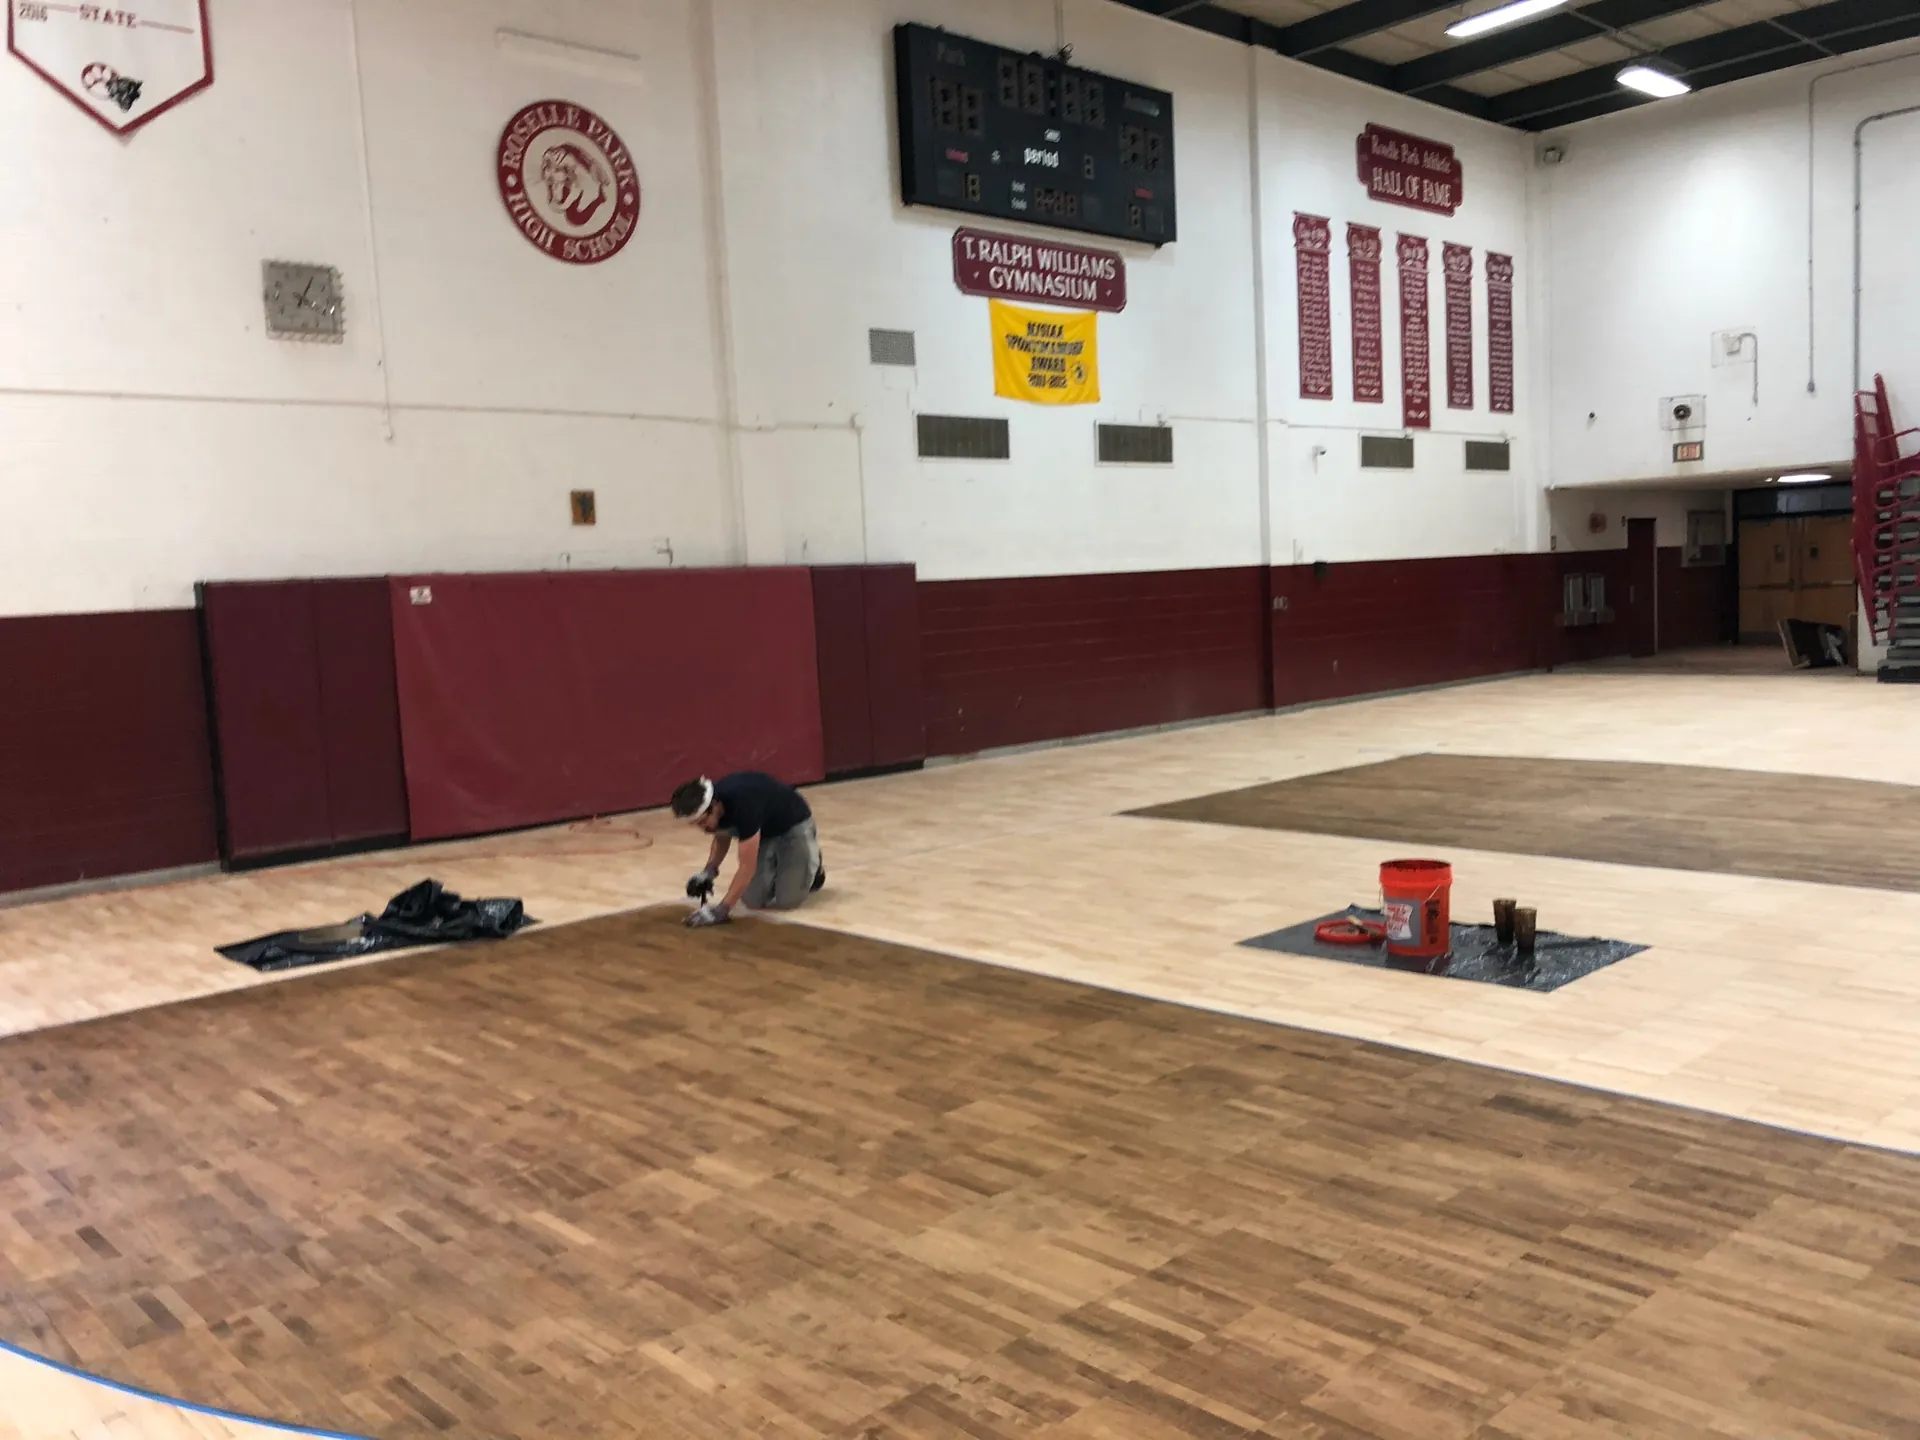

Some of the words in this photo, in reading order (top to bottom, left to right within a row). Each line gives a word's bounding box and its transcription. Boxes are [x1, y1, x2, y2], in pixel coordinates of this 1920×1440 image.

[79, 4, 137, 29] STATE
[502, 104, 580, 169] ROSELLE
[586, 118, 635, 189] PARK
[1023, 147, 1059, 168] period
[1372, 167, 1404, 197] HALL
[1404, 174, 1421, 200] OF
[1421, 178, 1452, 208] FAME
[507, 191, 557, 250] HIGH
[562, 212, 635, 260] SCHOOL
[961, 236, 977, 261] T.
[978, 239, 1034, 269] RALPH
[1036, 247, 1117, 281] WILLIAMS
[988, 266, 1098, 301] GYMNASIUM
